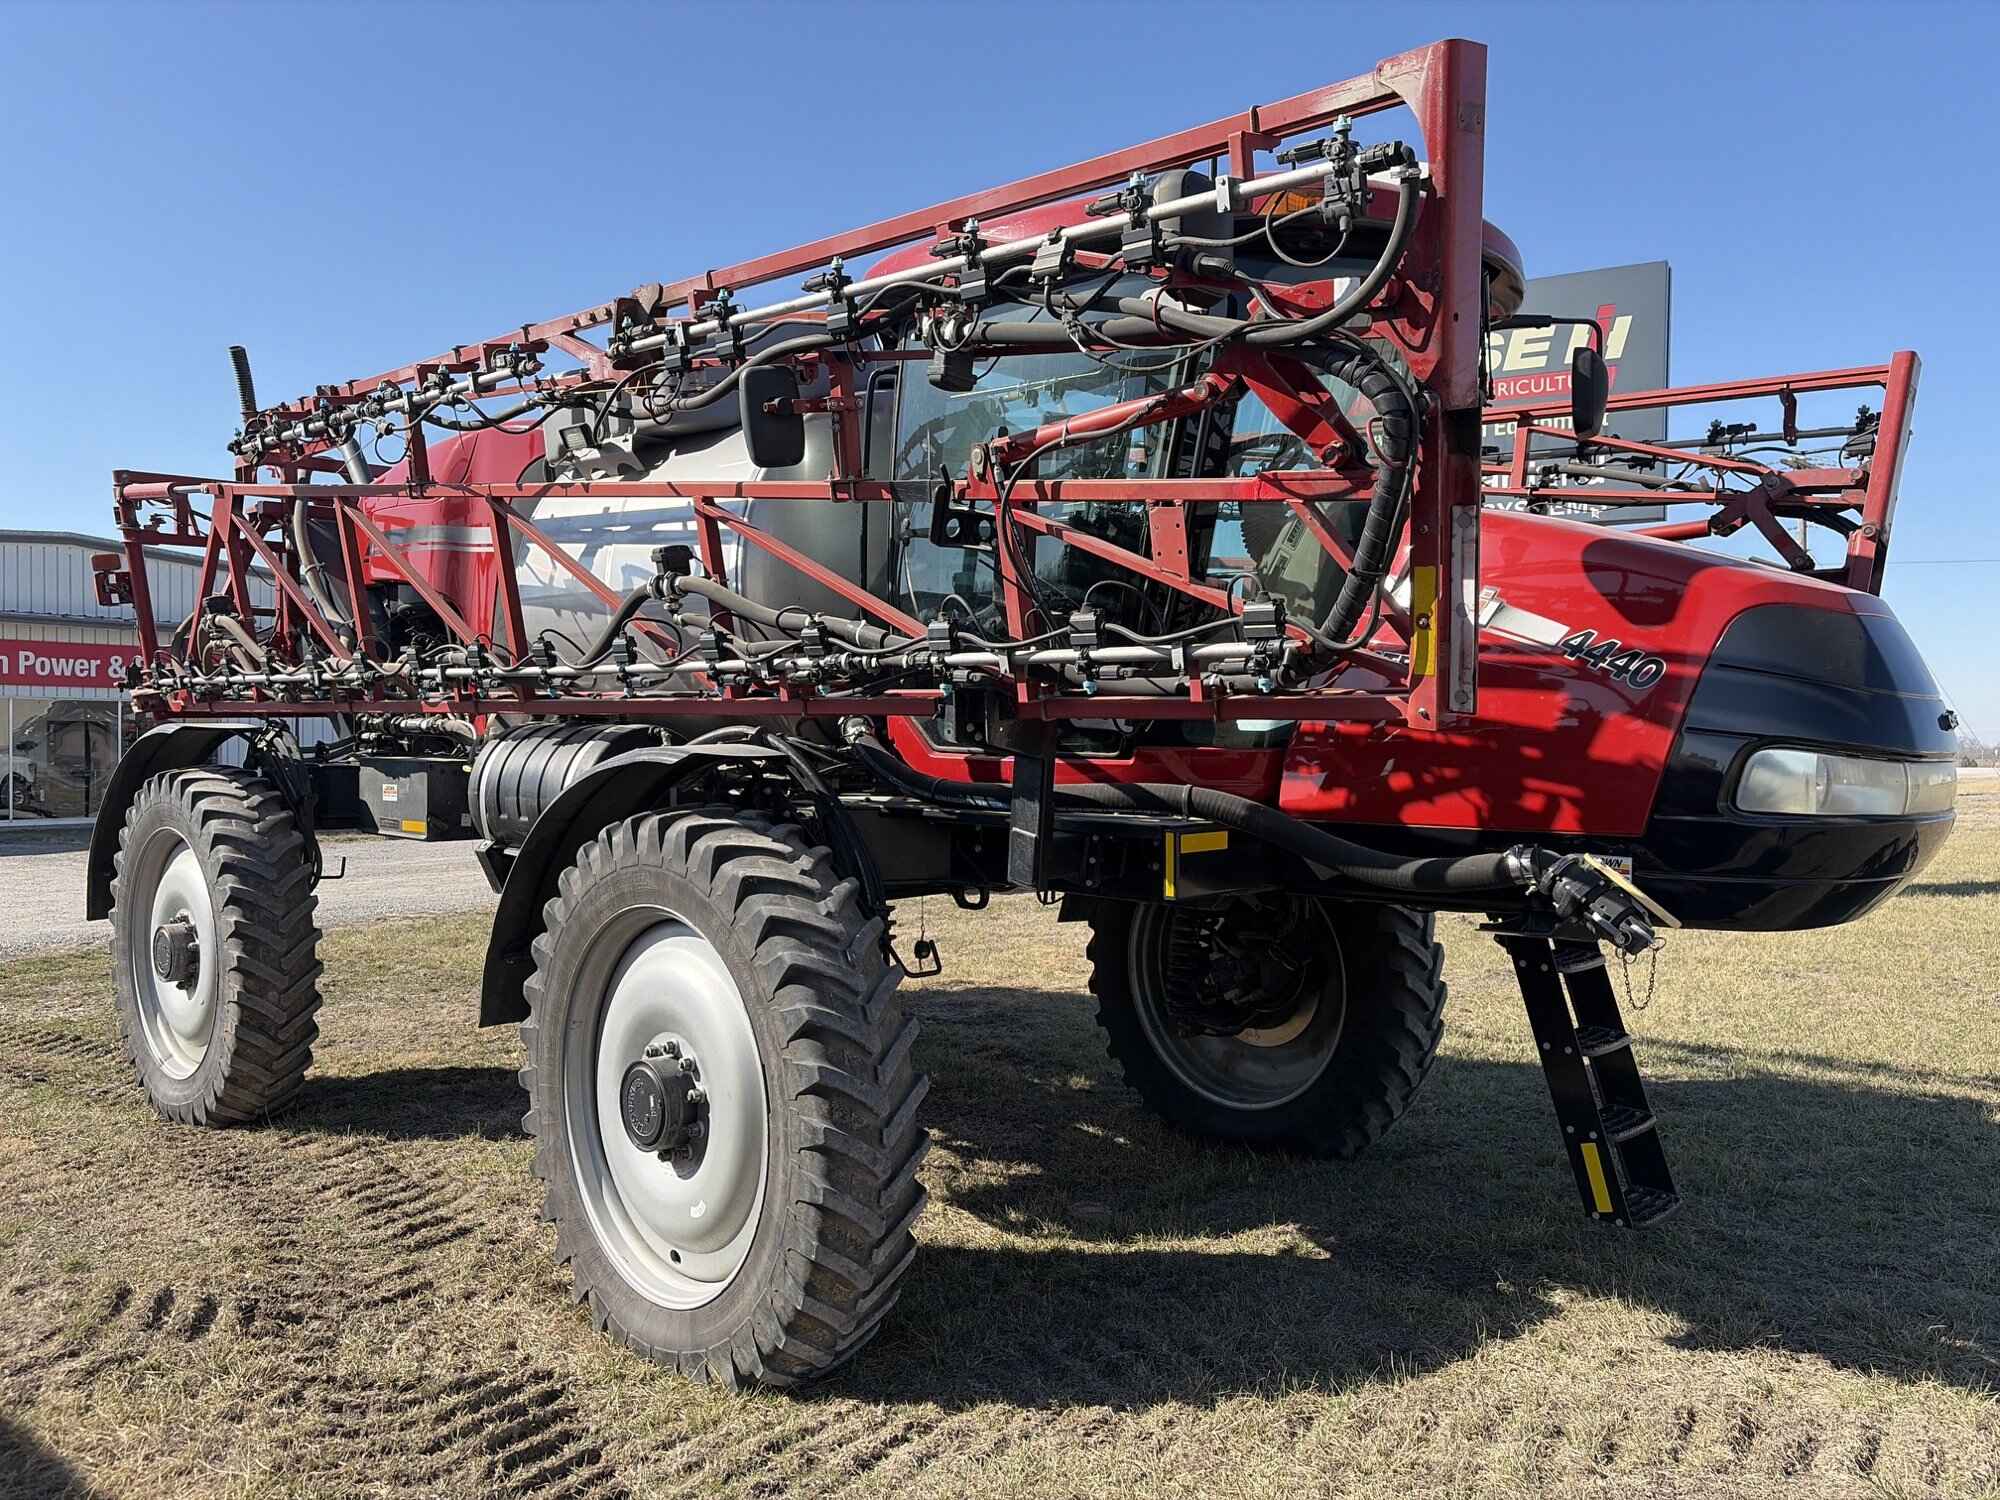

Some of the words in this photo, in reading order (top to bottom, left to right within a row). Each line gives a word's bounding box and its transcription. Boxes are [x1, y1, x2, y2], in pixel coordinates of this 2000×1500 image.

[18, 650, 101, 678] Power
[107, 655, 127, 679] &
[1560, 628, 1666, 690] 4440
